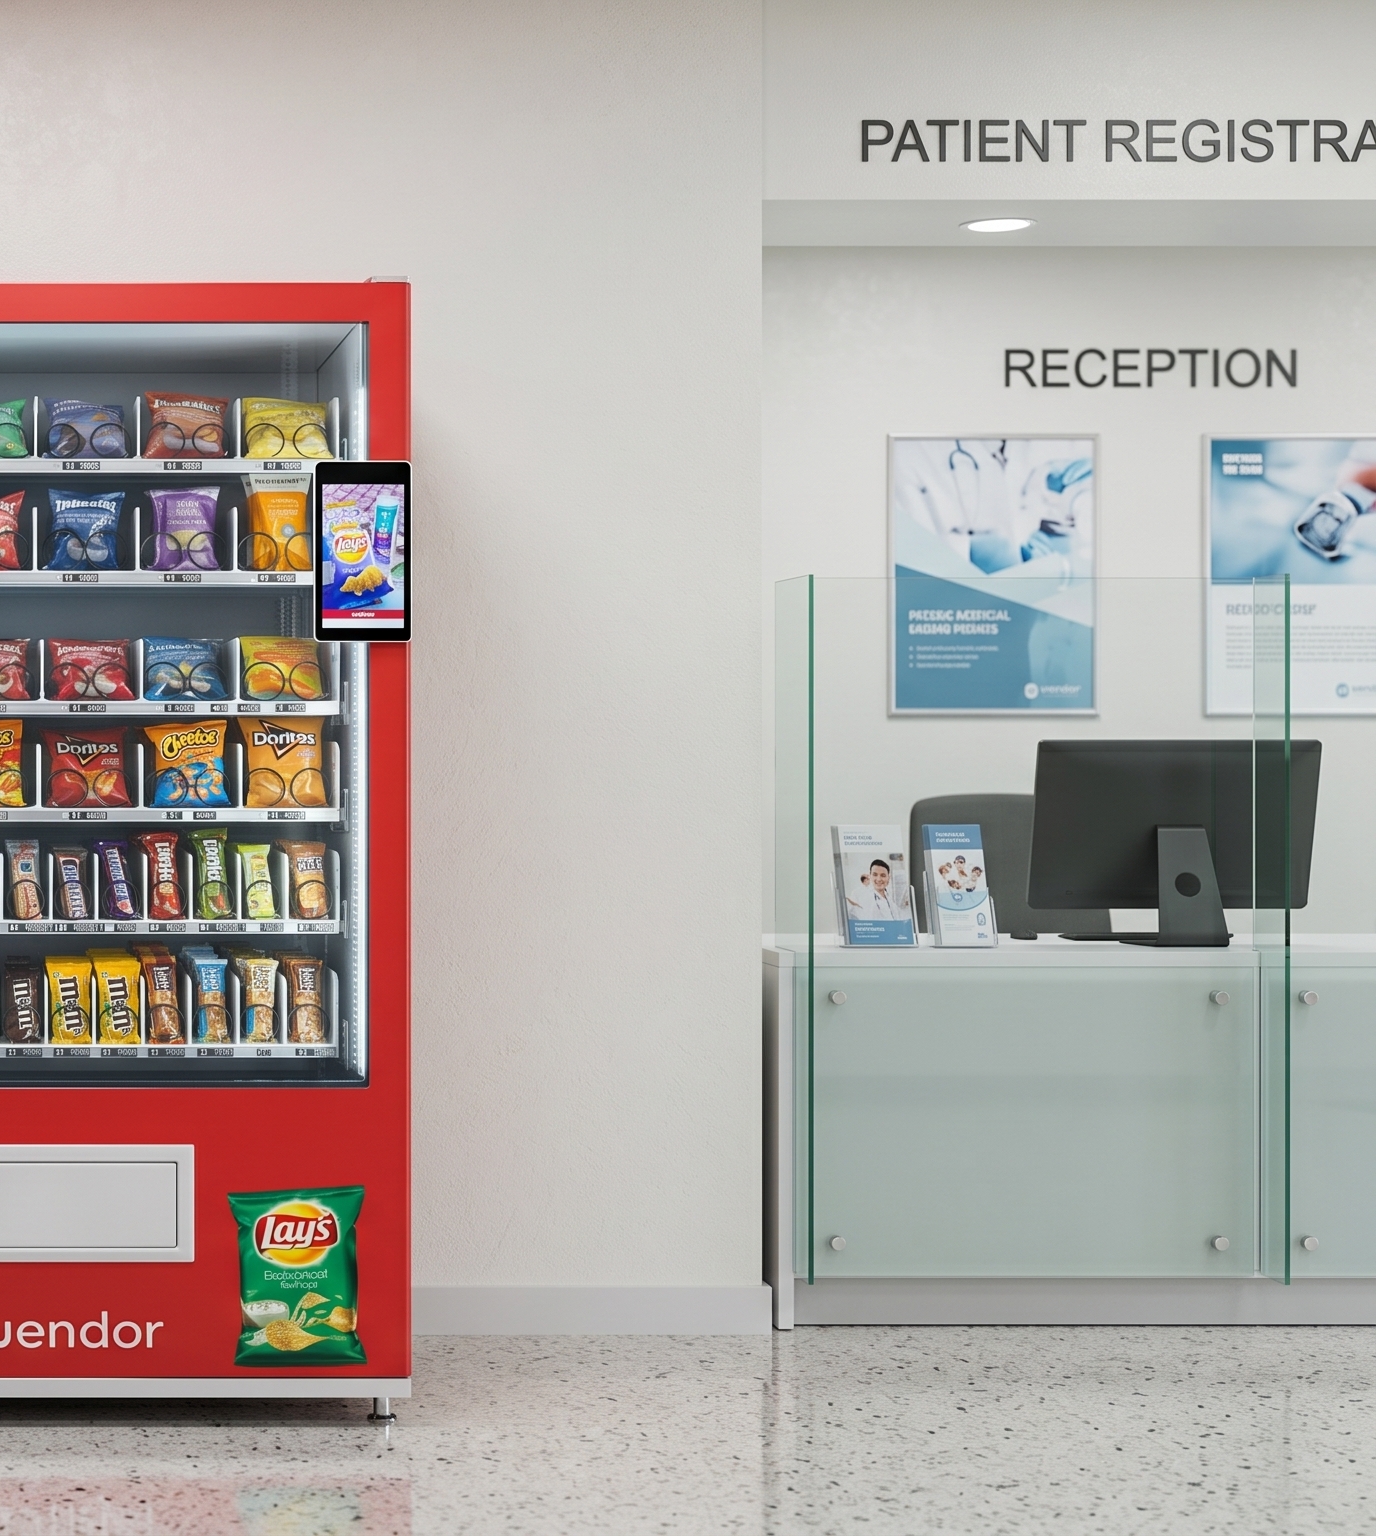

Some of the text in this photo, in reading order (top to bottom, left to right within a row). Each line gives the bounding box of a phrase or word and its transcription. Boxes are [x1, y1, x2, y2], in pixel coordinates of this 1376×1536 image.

[862, 119, 1376, 162] PATIENT REGISTRA
[1005, 349, 1296, 387] RECEPTION
[261, 1212, 333, 1250] Lay's
